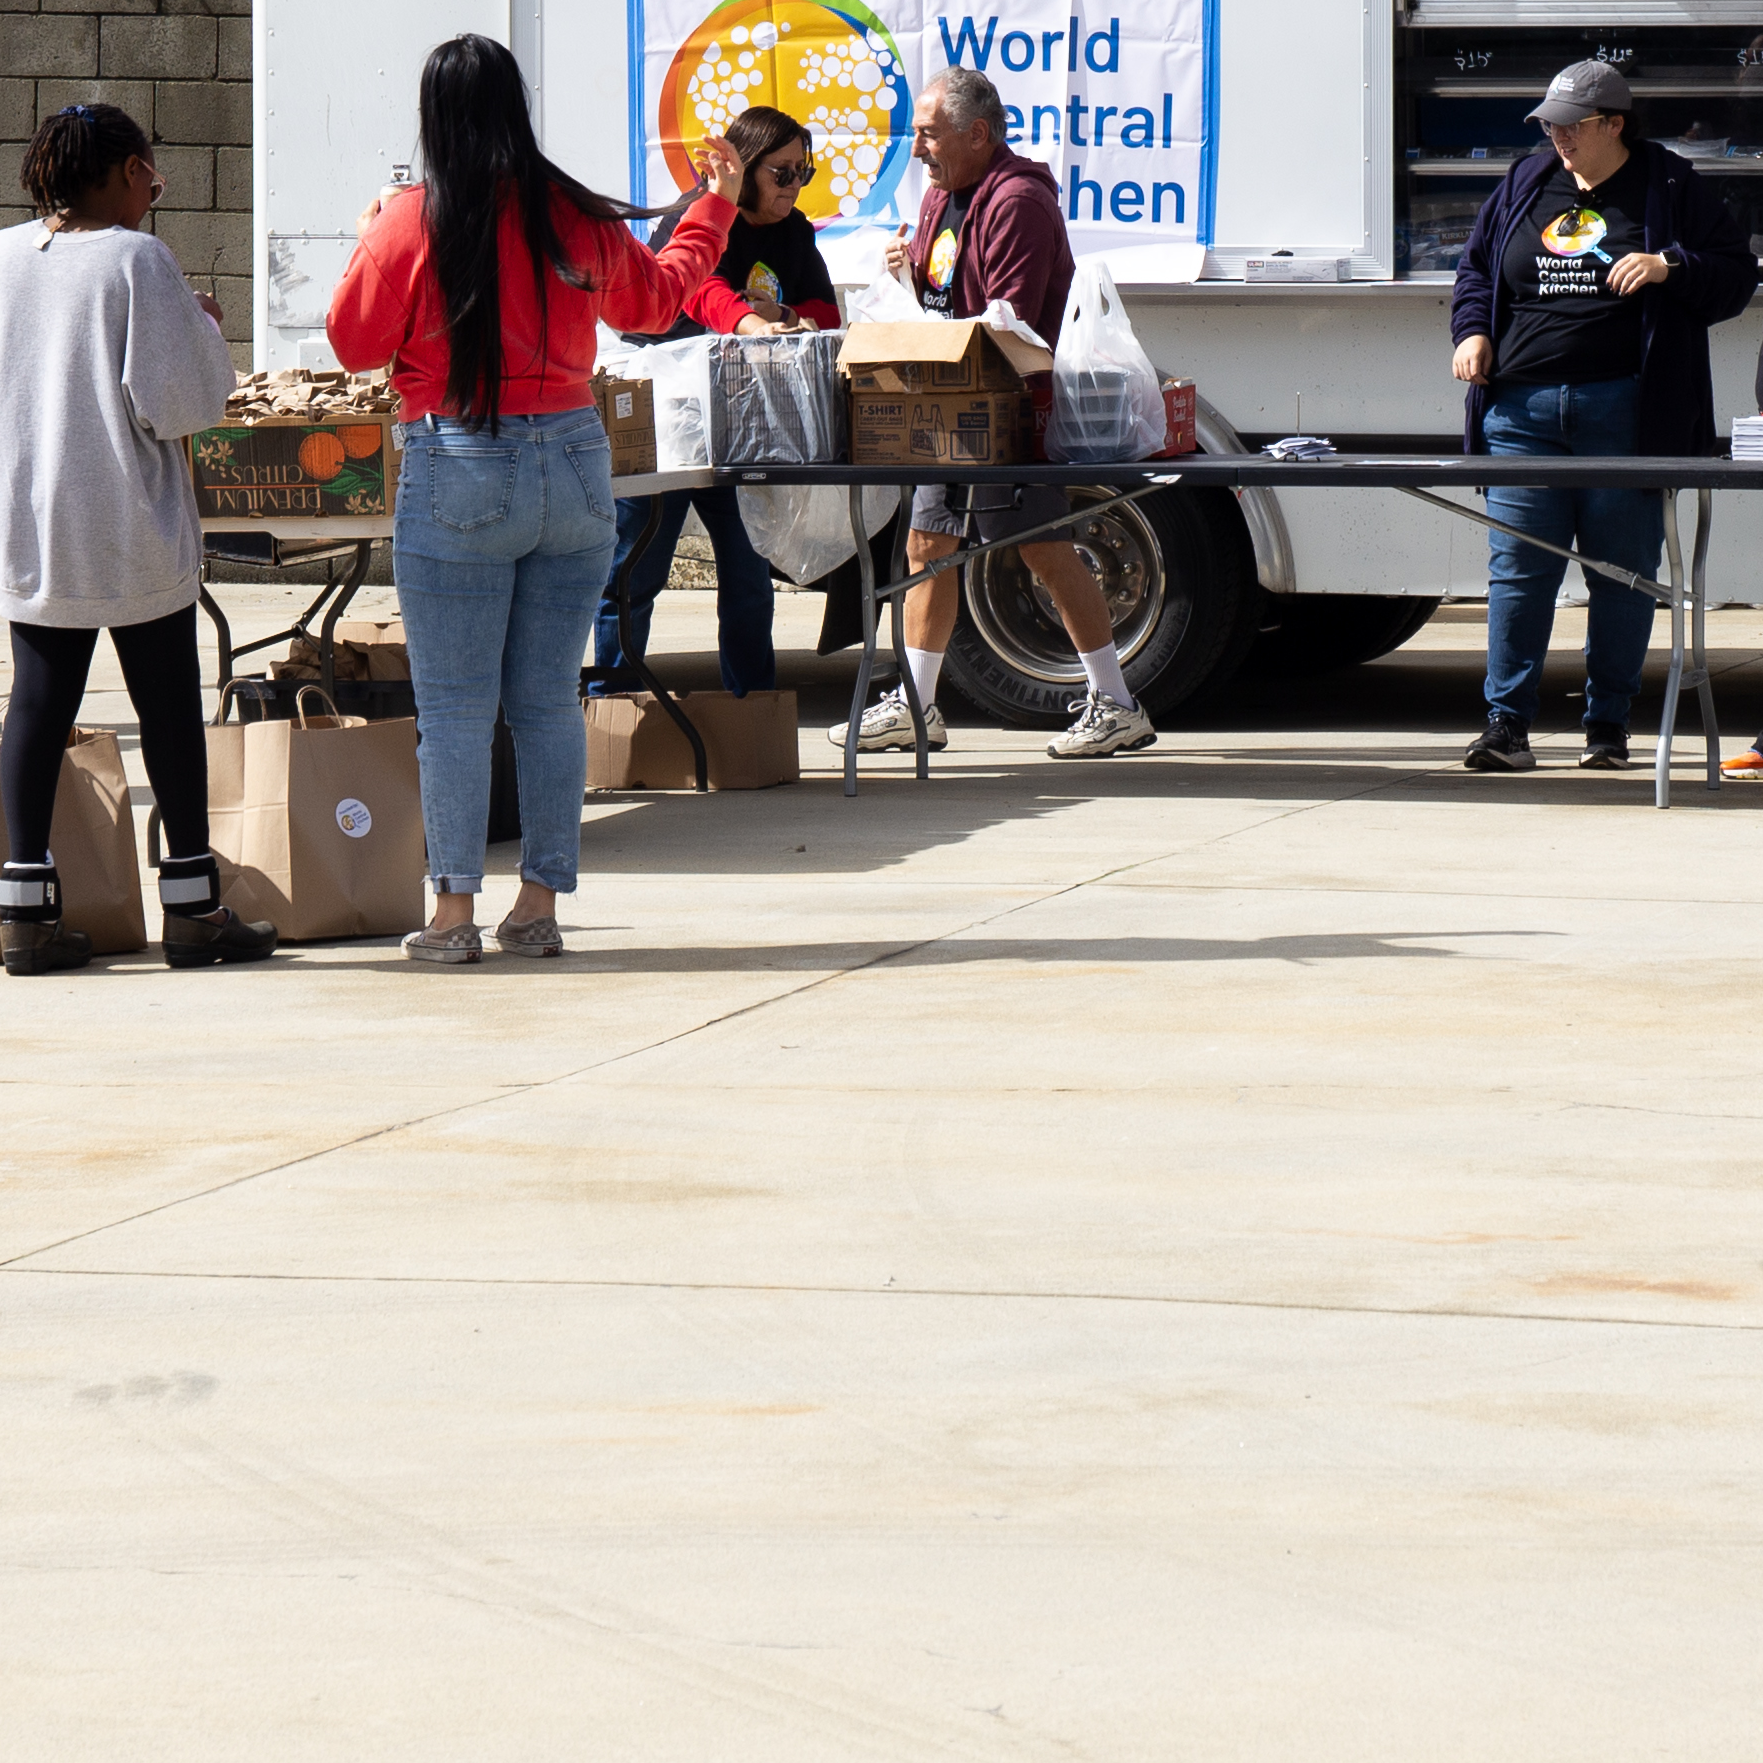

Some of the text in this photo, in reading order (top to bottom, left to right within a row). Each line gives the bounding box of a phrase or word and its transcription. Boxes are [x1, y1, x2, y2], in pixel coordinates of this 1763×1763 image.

[937, 15, 1120, 73] World
[1004, 93, 1173, 149] entral
[1441, 230, 1473, 240] KIRKLA
[1535, 256, 1583, 269] World
[1538, 270, 1596, 283] Central
[1539, 283, 1598, 296] Kitchen
[858, 405, 903, 416] T-SHIRT
[230, 464, 303, 485] CITRUS
[215, 488, 321, 510] PREMIUM
